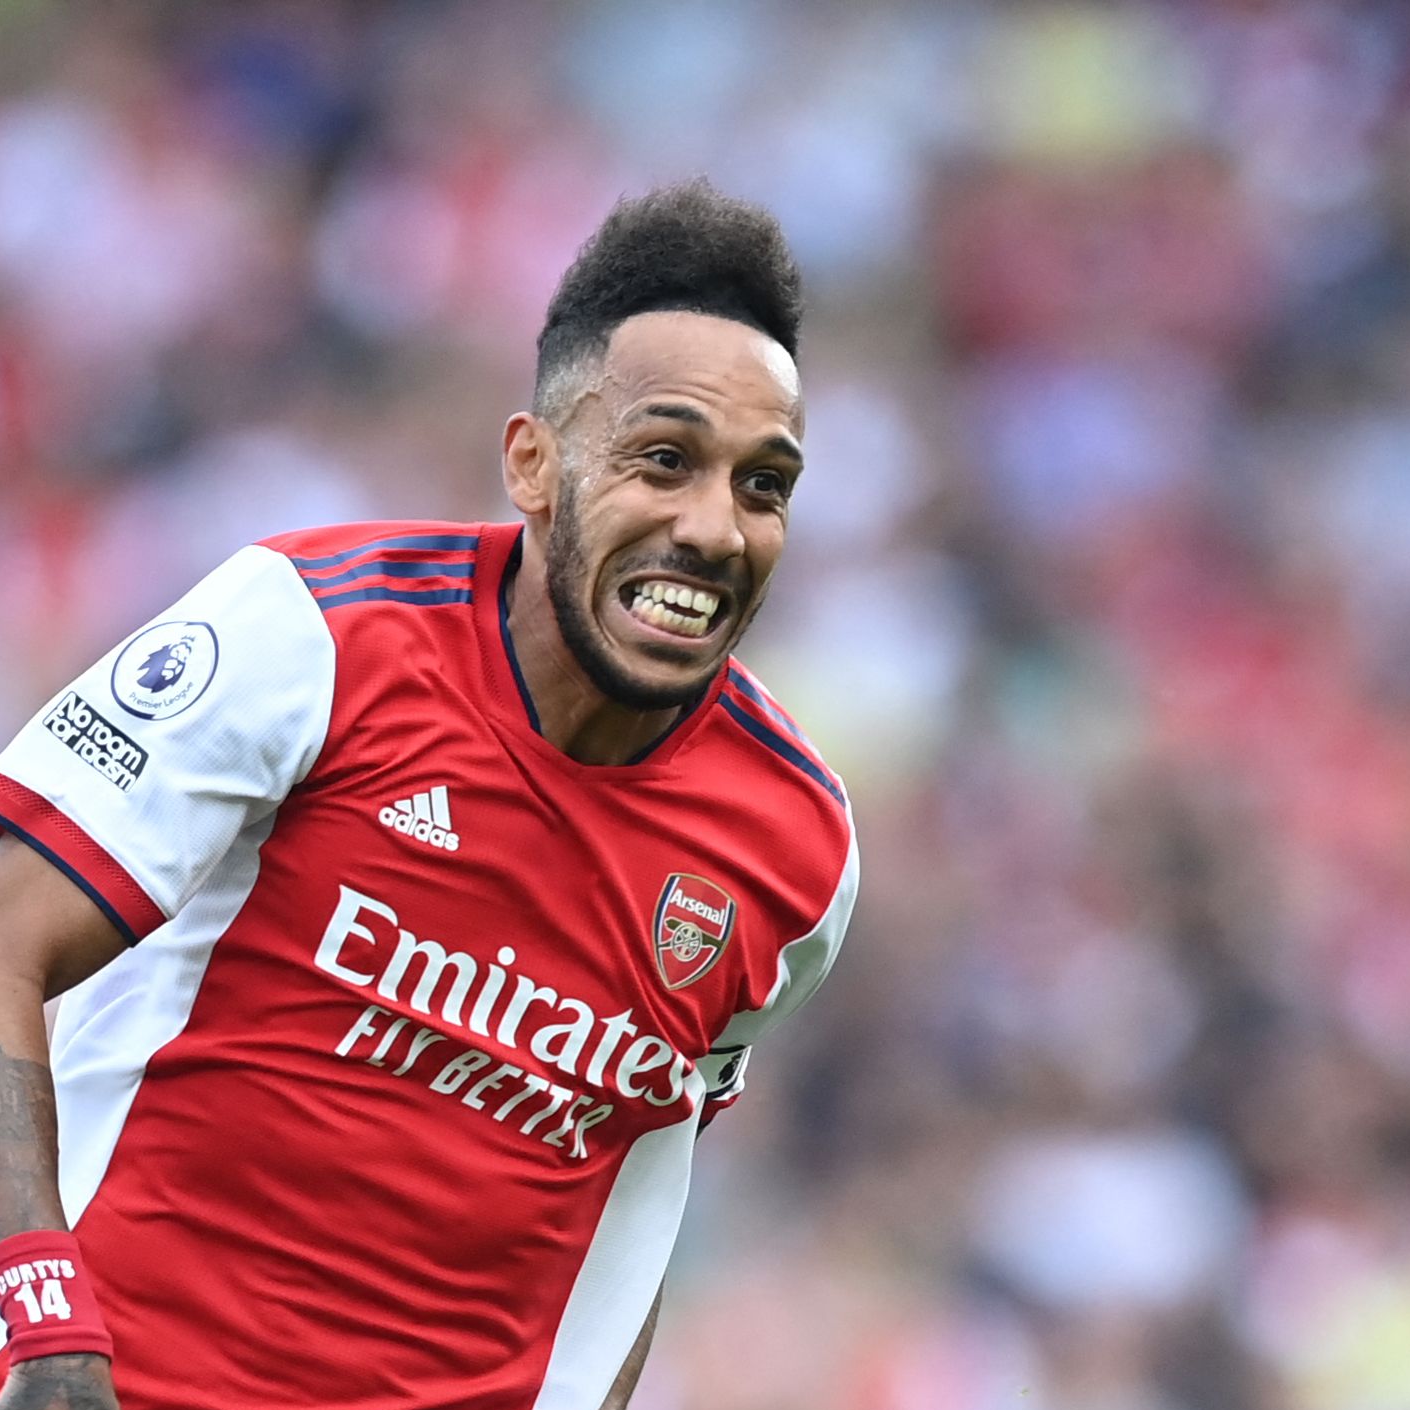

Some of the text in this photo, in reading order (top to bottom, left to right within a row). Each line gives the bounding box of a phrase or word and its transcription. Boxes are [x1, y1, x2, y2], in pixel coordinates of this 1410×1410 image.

[128, 681, 194, 710] Premier League
[55, 691, 143, 773] No room
[72, 734, 137, 793] racism
[378, 805, 460, 852] adidas
[669, 887, 726, 926] Arsenal
[313, 884, 691, 1107] Emirates
[333, 1004, 615, 1160] FLY BETTER
[13, 1278, 72, 1324] 14
